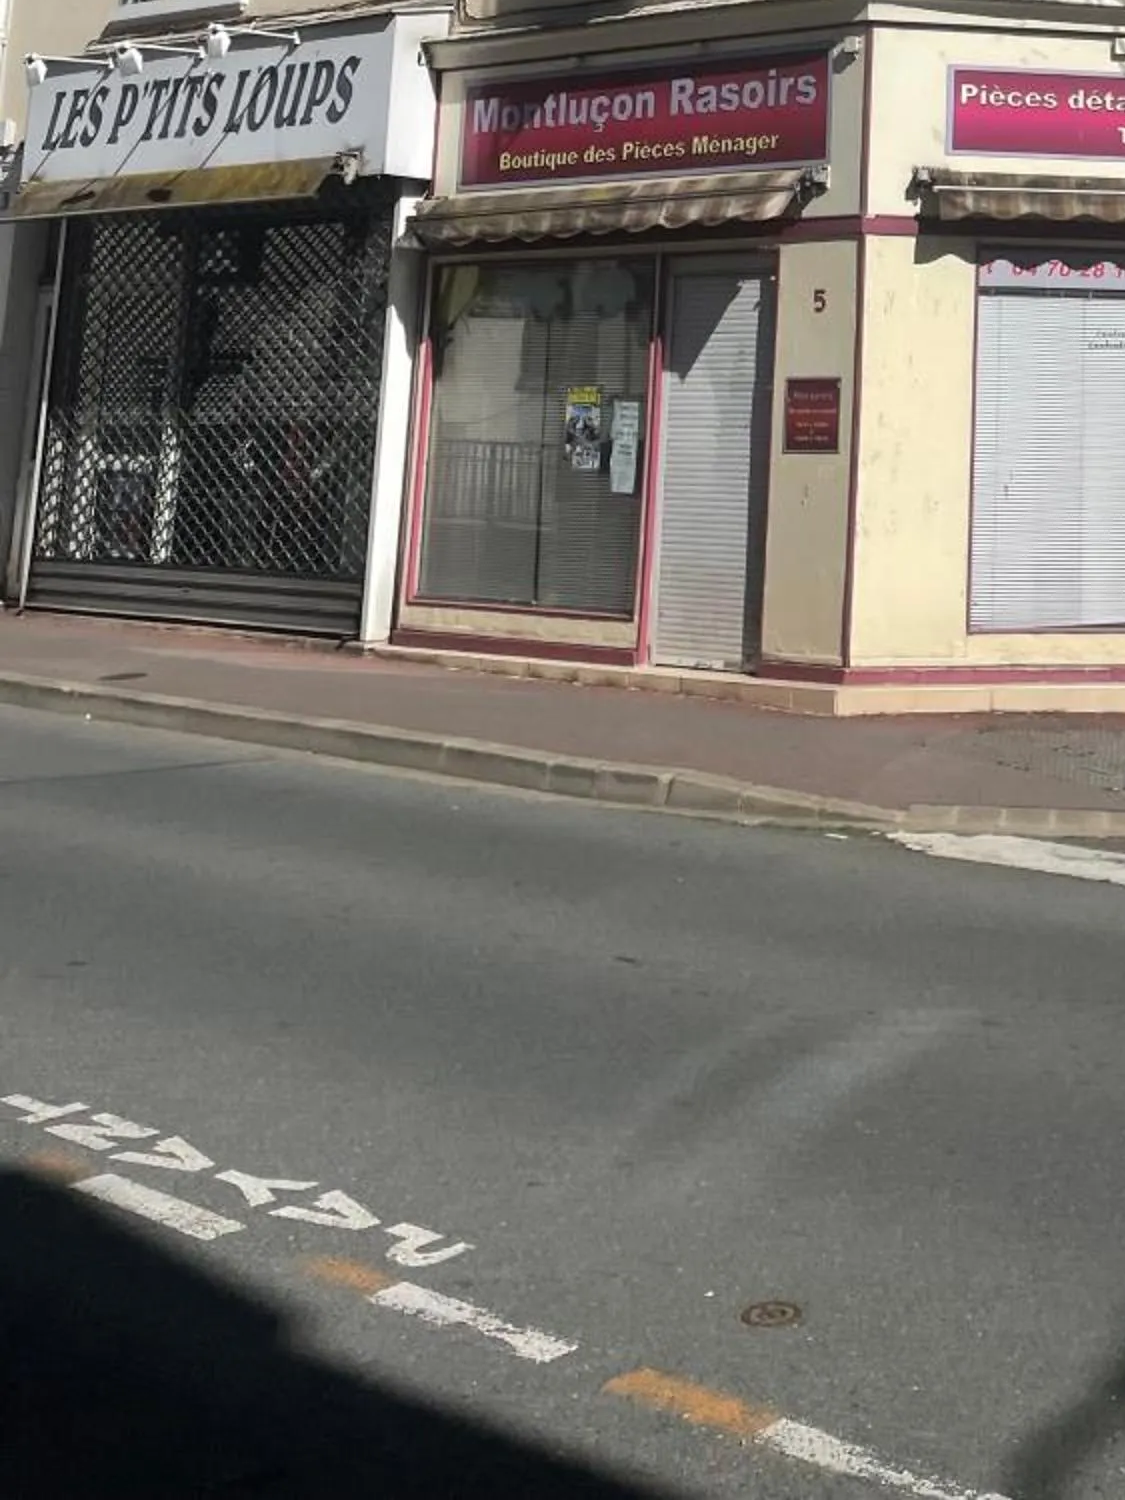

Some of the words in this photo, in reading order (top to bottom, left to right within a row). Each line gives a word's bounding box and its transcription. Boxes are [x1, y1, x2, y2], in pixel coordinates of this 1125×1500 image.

[41, 87, 110, 150] LES
[106, 72, 226, 145] P'TITS
[222, 56, 362, 134] LOUPS
[473, 90, 655, 134] Montluçon
[669, 68, 817, 117] Rasoirs
[960, 83, 1057, 108] Pièces
[499, 149, 579, 171] Boutique
[583, 144, 616, 163] des
[1047, 260, 1071, 277] 70
[813, 289, 827, 313] 5
